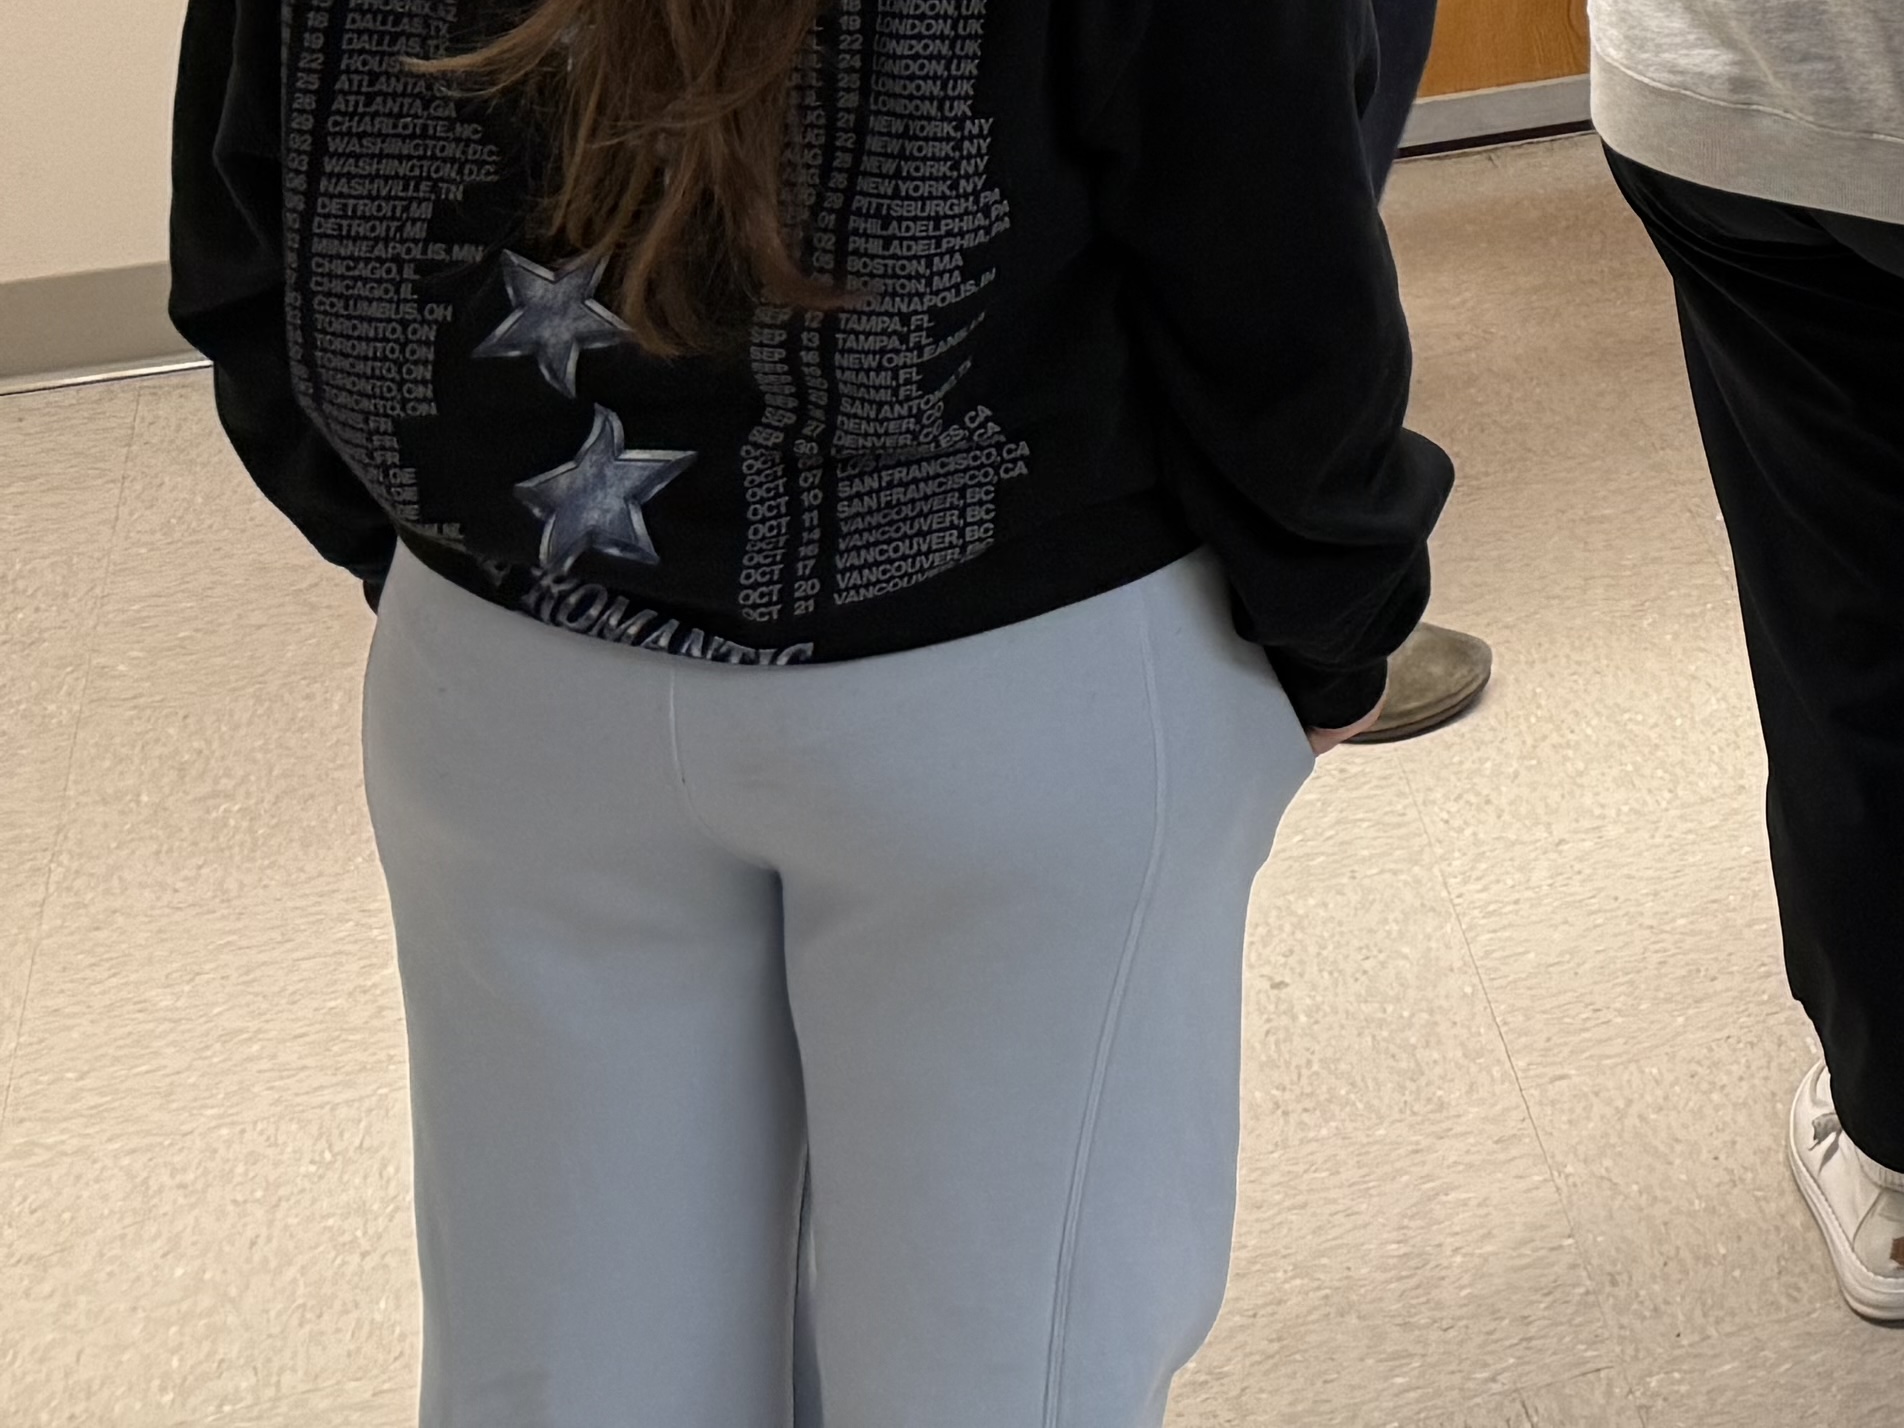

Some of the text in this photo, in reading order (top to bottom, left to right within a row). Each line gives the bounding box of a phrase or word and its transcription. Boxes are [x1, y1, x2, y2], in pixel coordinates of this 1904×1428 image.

[875, 14, 985, 38] LONDON, UK
[872, 33, 982, 57] LONDON, UK
[871, 54, 980, 78] LONDON, UK
[870, 72, 977, 98] LONDON, UK
[869, 91, 974, 118] LONDON, UK
[868, 114, 904, 133] NEW
[864, 133, 901, 155] NEW
[859, 154, 900, 175] NEW
[856, 175, 896, 196] NEW
[851, 195, 978, 218] PITTSBURGH,
[847, 212, 990, 237] PHILADELPHIA,
[846, 252, 964, 277] BOSTON, MA
[931, 270, 963, 291] MA
[424, 303, 454, 322] OH
[839, 313, 908, 333] TAMPA,
[407, 322, 437, 342] ON
[834, 332, 906, 351] TAMPA,
[833, 351, 880, 369] NEW
[834, 369, 897, 386] MIAMI,
[881, 448, 1001, 489] FRANCISCO,
[1002, 440, 1031, 461] CA
[879, 461, 1029, 508] FRANCISCO, CA
[840, 490, 965, 534] VANCOUVER,
[838, 509, 964, 553] VANCOUVER,
[739, 529, 963, 584] OCT VANCOUVER,
